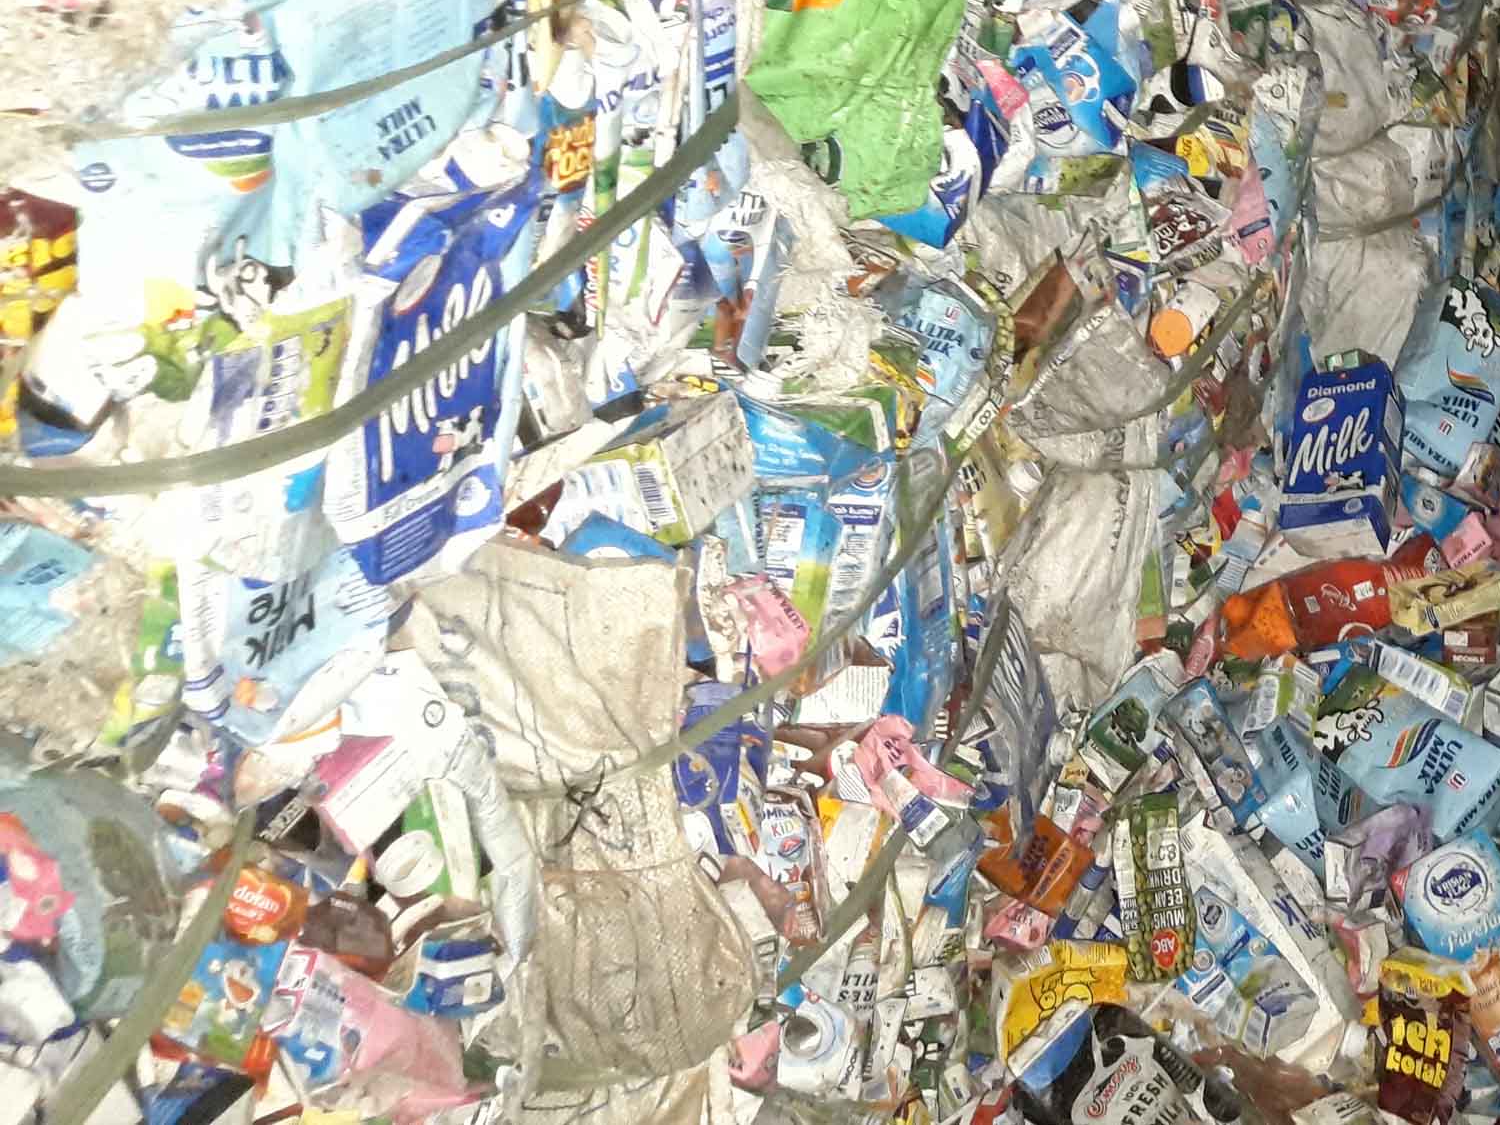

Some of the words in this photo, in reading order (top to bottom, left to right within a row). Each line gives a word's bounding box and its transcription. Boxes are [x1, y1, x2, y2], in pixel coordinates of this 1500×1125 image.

[1307, 378, 1377, 399] Diamond
[1288, 407, 1376, 488] Milk
[1416, 734, 1446, 782] MILK
[1425, 740, 1463, 795] ULTRA
[1153, 890, 1185, 908] BEAN
[1153, 910, 1186, 930] MUNG
[1391, 1013, 1452, 1065] teh
[1385, 1045, 1447, 1090] kotak
